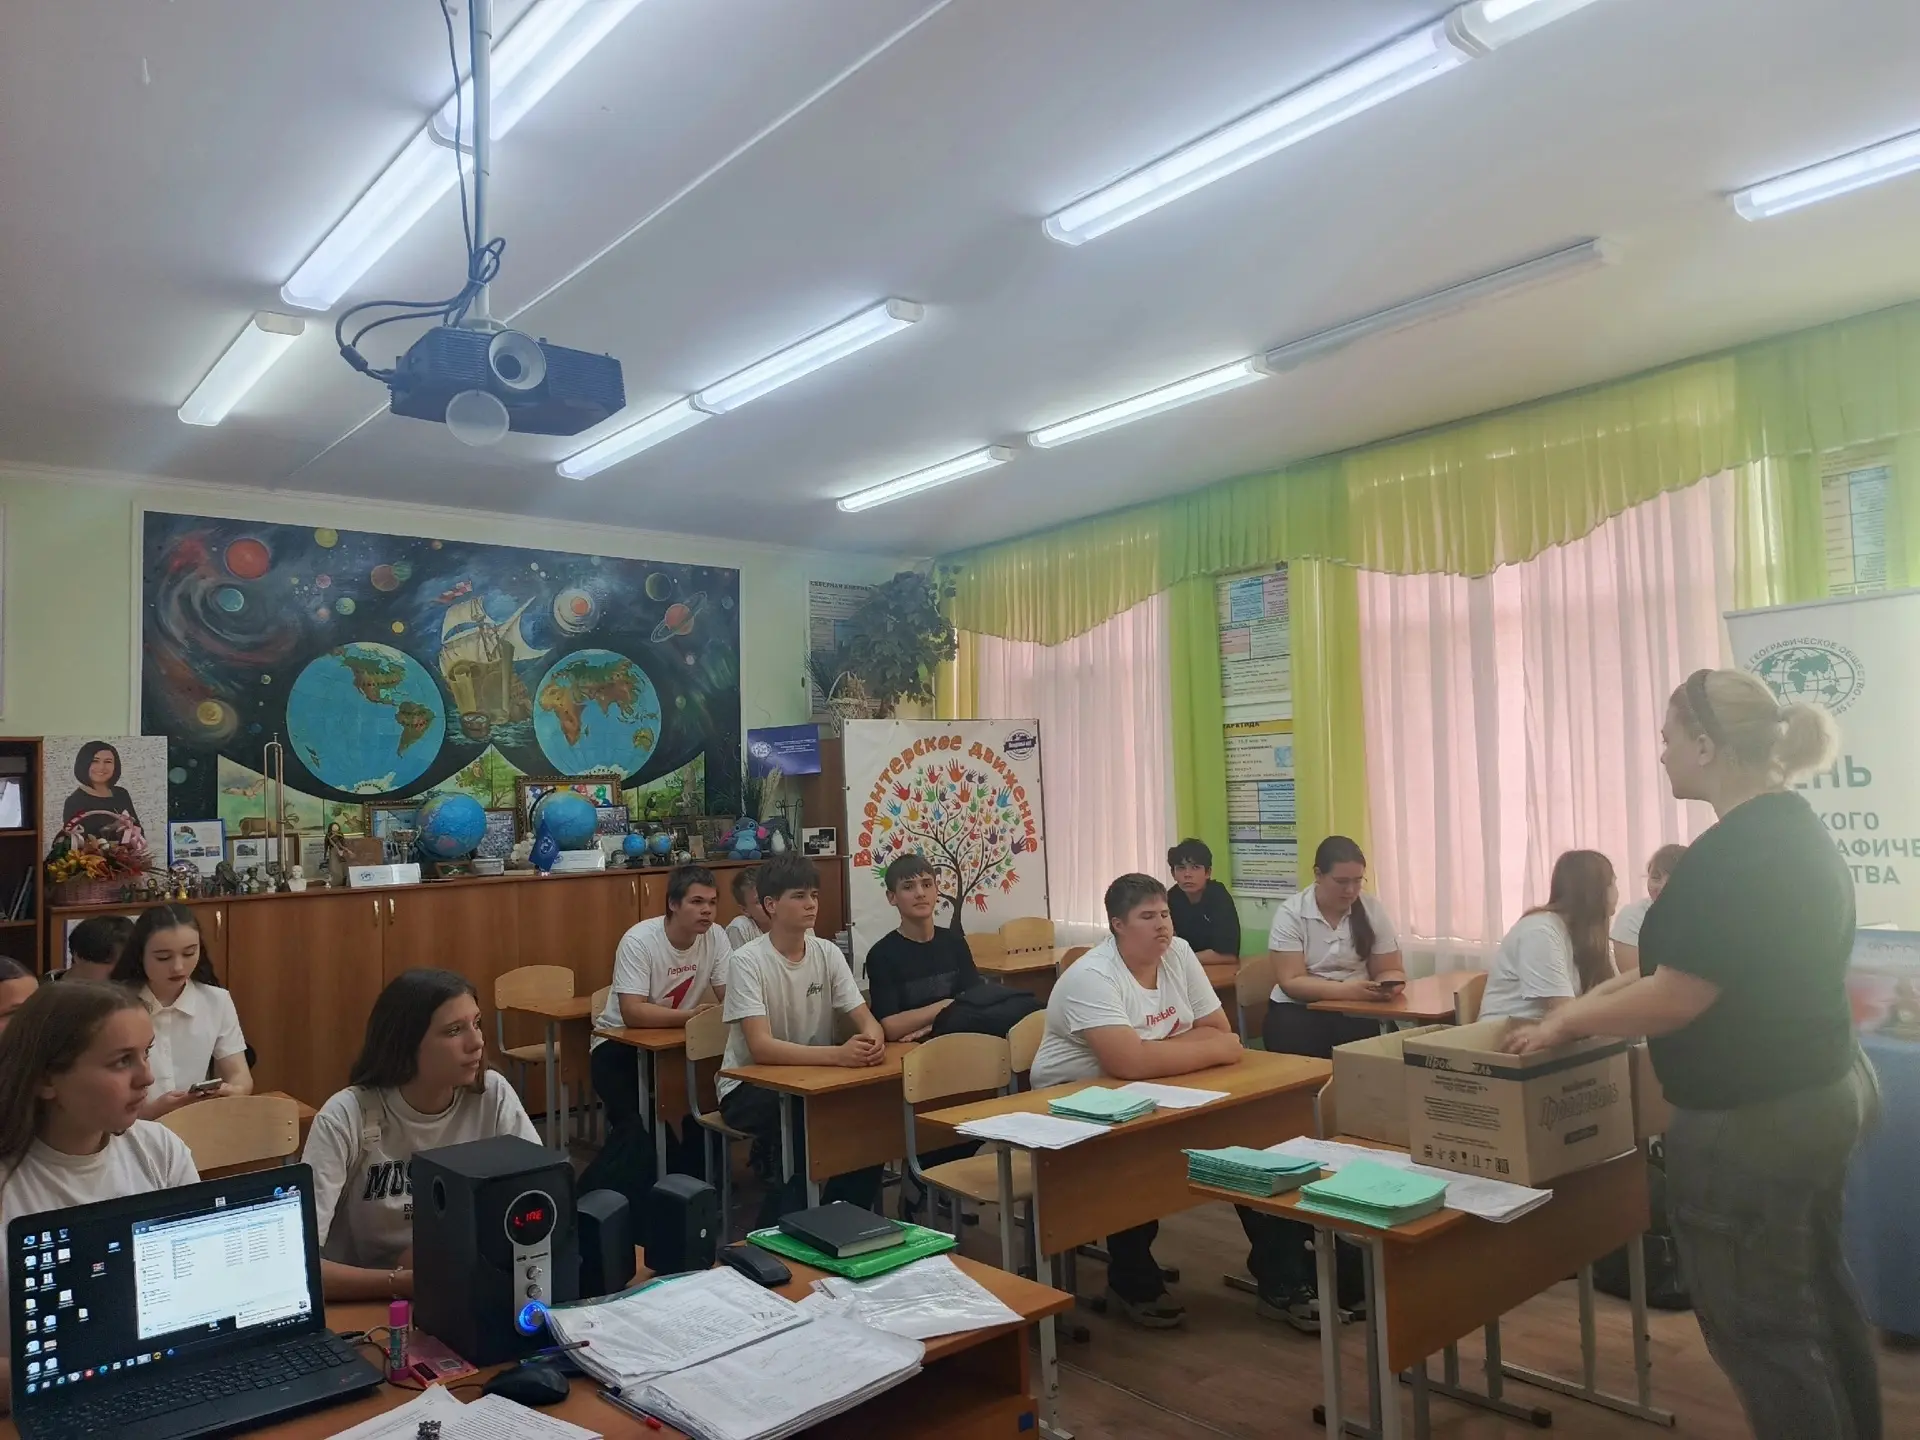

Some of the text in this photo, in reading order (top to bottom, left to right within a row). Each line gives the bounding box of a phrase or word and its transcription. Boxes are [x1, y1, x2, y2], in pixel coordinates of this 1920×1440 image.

[1748, 637, 1838, 665] ГЕОГРАФИЧЕСКОЕ
[1838, 646, 1866, 697] ОБЩЕСТВО
[853, 735, 1037, 867] ВОЛОНТЕРСКОЕ ДВИЖЕНИЕ
[1820, 811, 1879, 831] КОГО
[1849, 865, 1901, 885] ТВА
